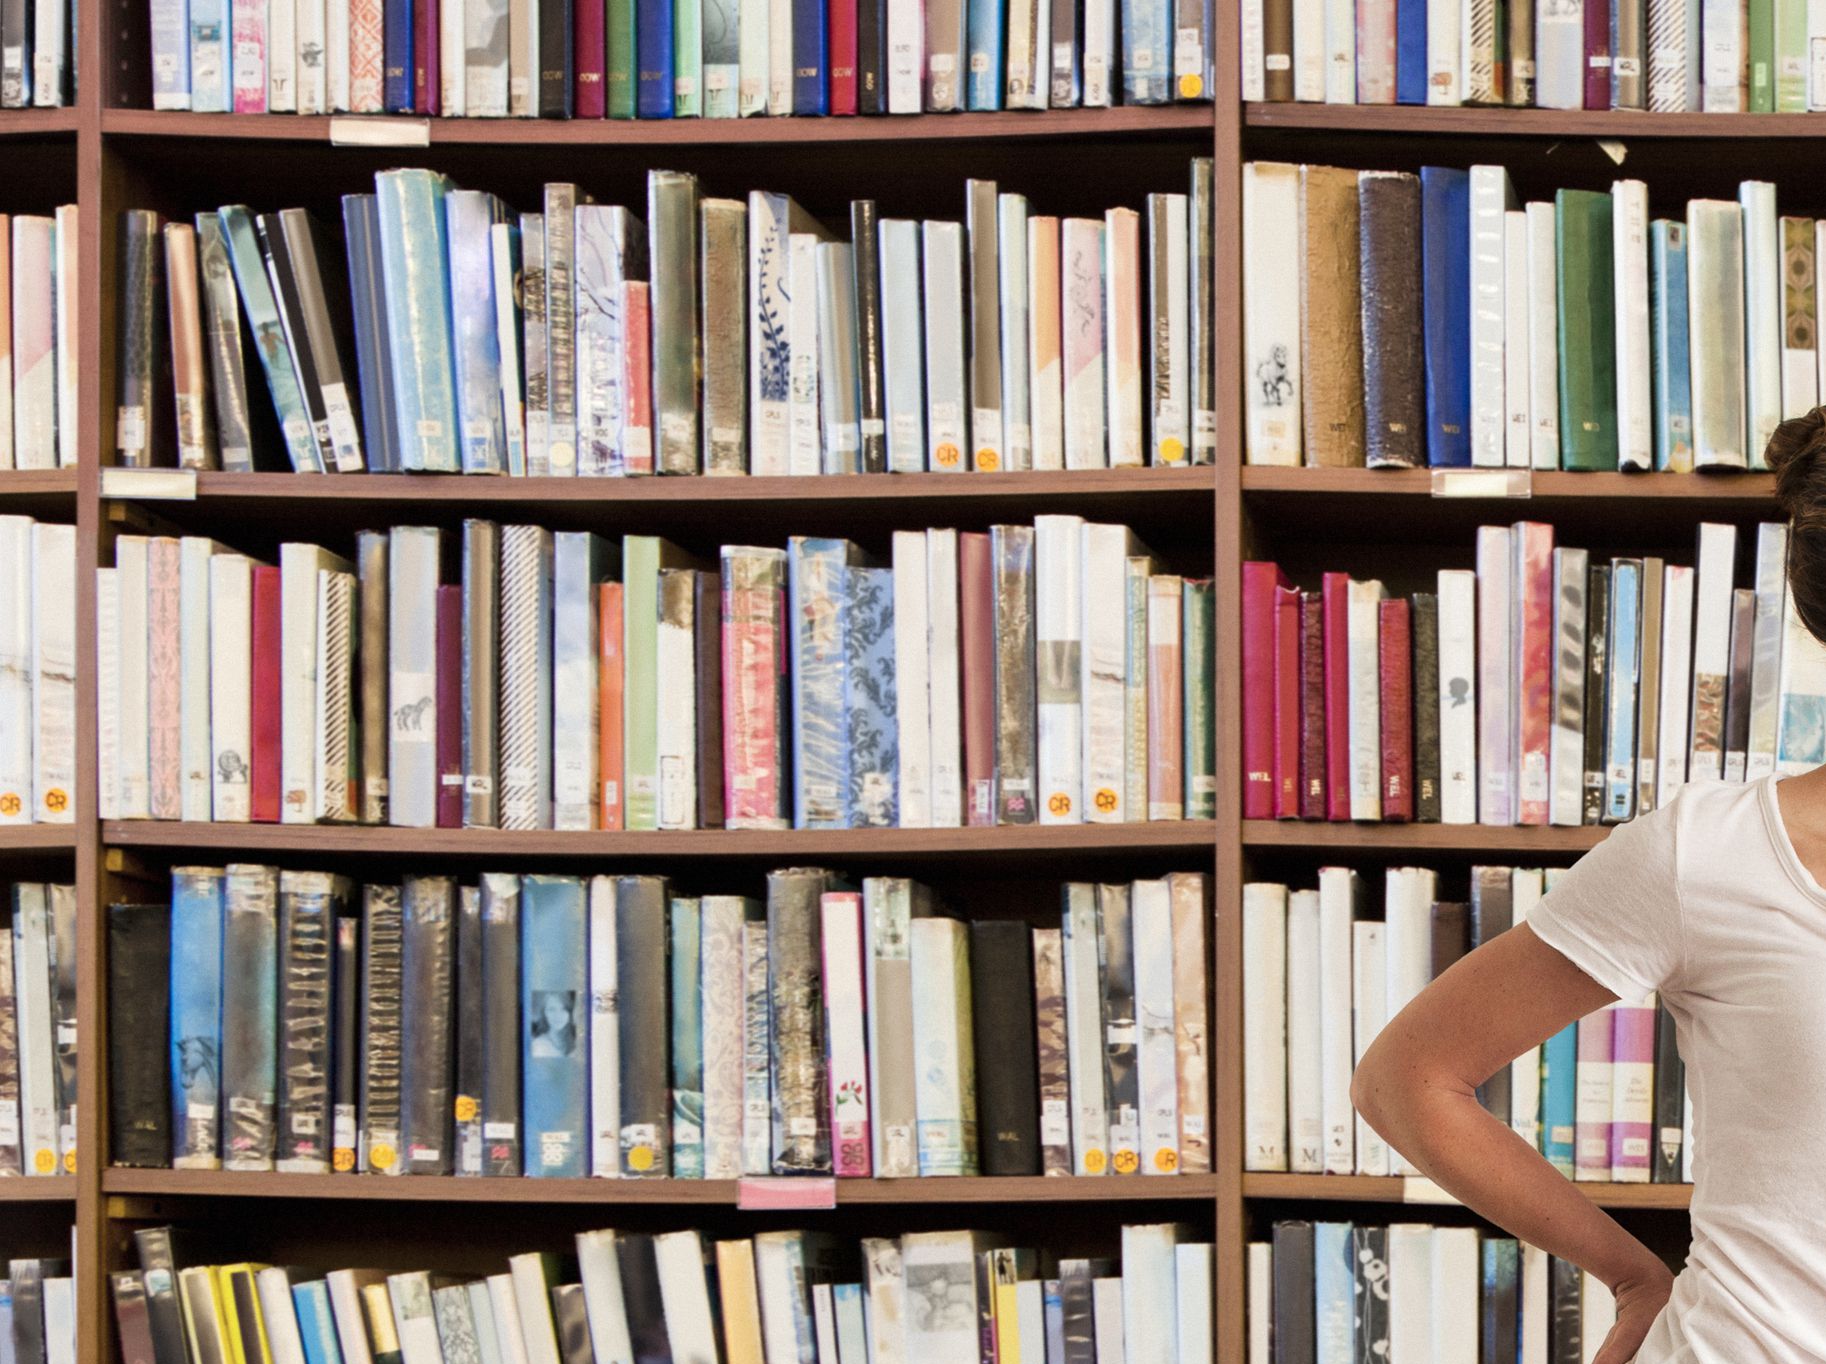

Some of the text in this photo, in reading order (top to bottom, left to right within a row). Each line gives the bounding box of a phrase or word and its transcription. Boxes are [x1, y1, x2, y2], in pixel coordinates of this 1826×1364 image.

[936, 447, 958, 463] CR
[977, 452, 998, 467] CR
[1249, 771, 1271, 782] WEL
[1311, 779, 1320, 795] WEL
[1389, 776, 1400, 797] WEL
[1423, 779, 1433, 799] WEL
[0, 797, 21, 813] CR
[46, 794, 67, 808] CR
[1049, 796, 1070, 813] CR
[1096, 794, 1116, 809] CR
[1114, 1152, 1138, 1168] CR
[1302, 1148, 1317, 1163] M
